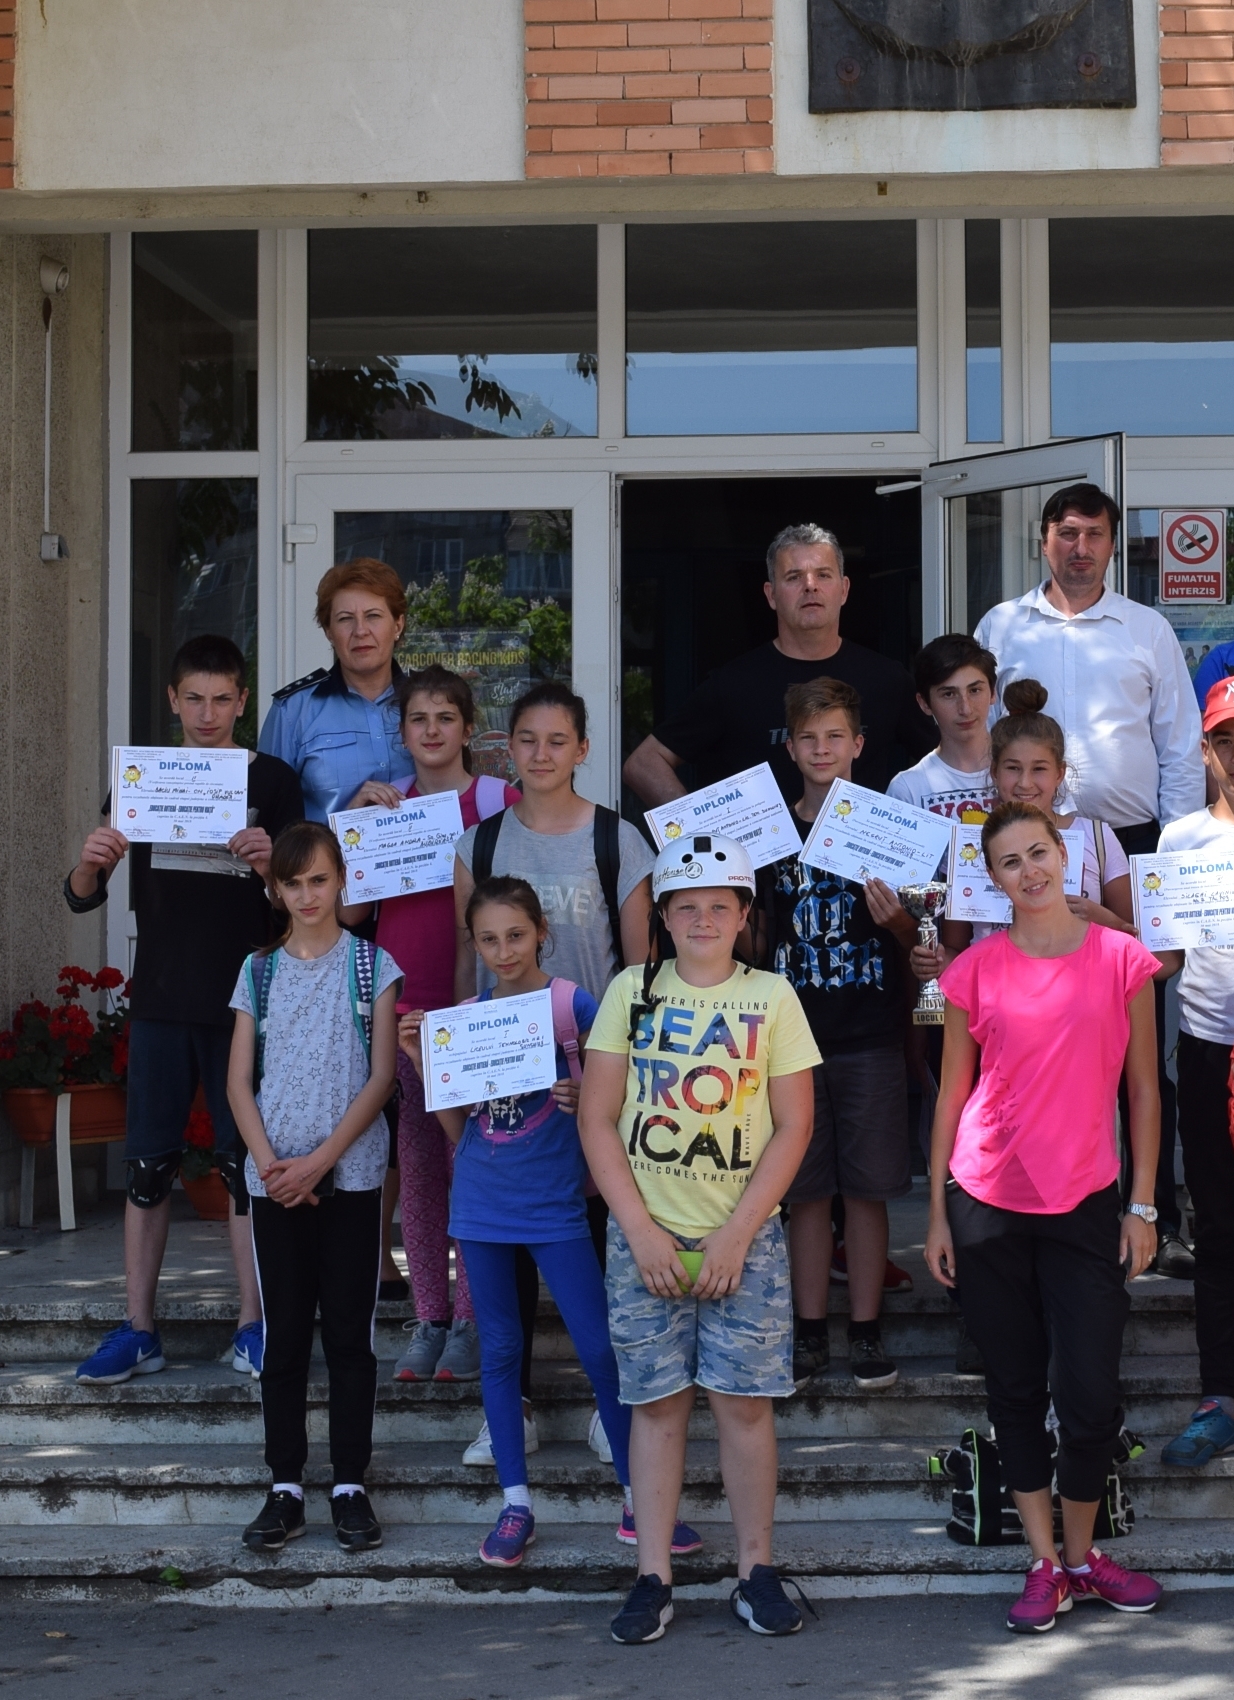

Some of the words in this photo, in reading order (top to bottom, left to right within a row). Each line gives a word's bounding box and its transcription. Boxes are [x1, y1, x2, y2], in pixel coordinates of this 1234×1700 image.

[1167, 574, 1217, 583] FUMATUL
[1168, 587, 1216, 596] INTERZIS
[398, 652, 454, 667] CARCOVER
[457, 652, 497, 666] RACING
[501, 651, 525, 665] KIDS
[159, 760, 212, 772] DIPLOMĂ
[376, 809, 426, 827] DIPLOMĂ
[870, 806, 918, 831] DIPLOMĂ
[1179, 861, 1233, 875] DIPLOMĂ
[632, 991, 686, 1007] SMMER
[692, 998, 705, 1008] IS
[713, 1001, 768, 1011] CALLING
[468, 1014, 519, 1032] DIPLOMĂ
[916, 1014, 939, 1022] LOCUL
[630, 1003, 766, 1061] BEAT
[632, 1055, 761, 1116] TROP
[628, 1110, 752, 1171] ICAL
[629, 1160, 652, 1172] ERE
[656, 1166, 698, 1181] COMES
[702, 1172, 725, 1182] THE
[732, 1173, 750, 1184] SUN
